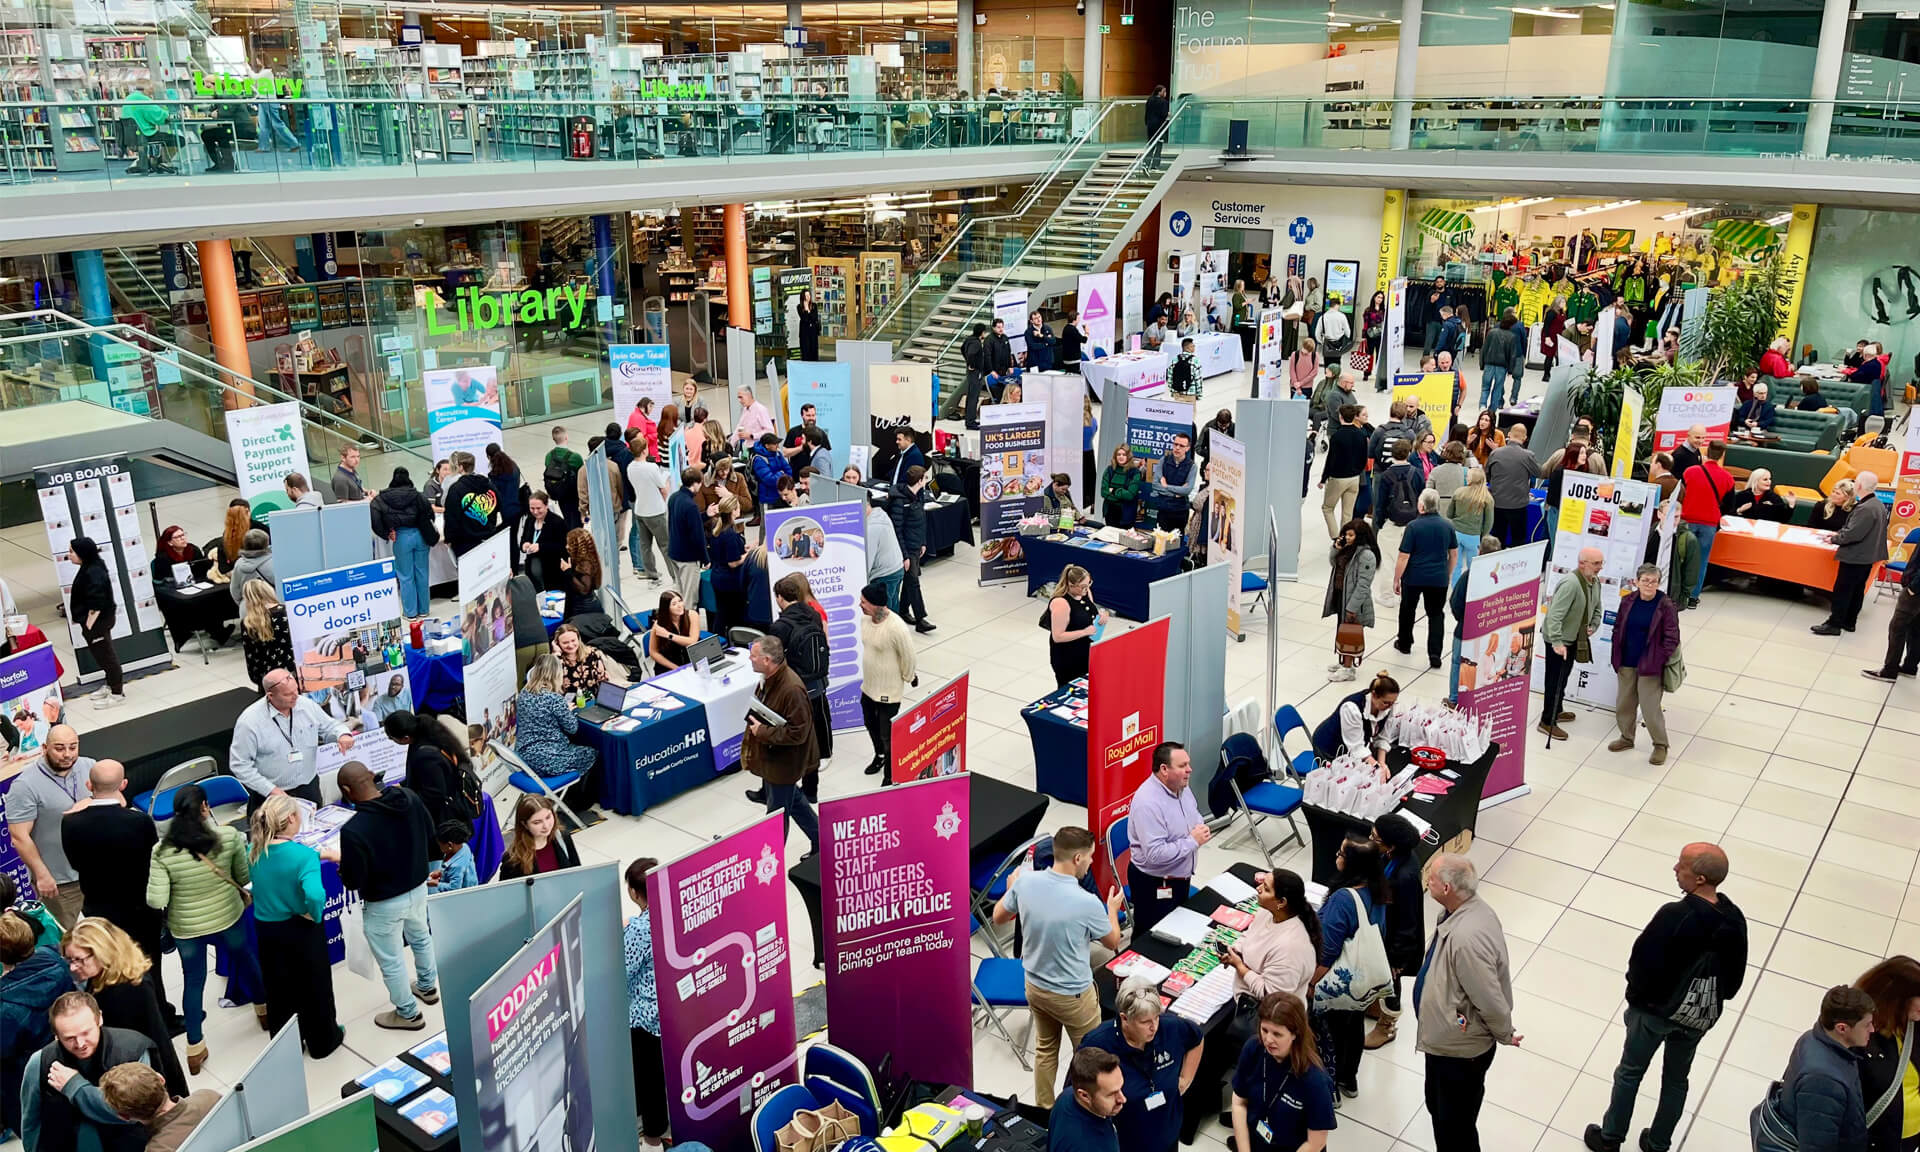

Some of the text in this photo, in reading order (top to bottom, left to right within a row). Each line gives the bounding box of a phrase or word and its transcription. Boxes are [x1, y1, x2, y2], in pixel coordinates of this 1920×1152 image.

[1178, 6, 1215, 28] The
[1178, 33, 1244, 54] Forum
[1176, 60, 1220, 80] Trust
[193, 70, 302, 99] Library
[640, 78, 706, 101] Library
[1211, 200, 1265, 213] Customer
[1214, 213, 1260, 224] Services
[1380, 232, 1394, 254] City
[1450, 229, 1475, 248] CITY
[1378, 258, 1388, 279] Stall
[425, 283, 588, 336] Library
[612, 352, 628, 360] Join
[1668, 404, 1728, 413] TECHNIQUE
[242, 434, 277, 447] Direct
[985, 430, 1041, 442] UK'S LARGEST
[1005, 439, 1040, 448] BUSINESSES
[1131, 428, 1176, 443] THE FOO
[1131, 438, 1165, 448] INDUSTRY
[244, 443, 296, 460] Payment
[1131, 446, 1151, 454] FARM
[247, 456, 292, 472] Support
[48, 464, 120, 486] JOB BOARD
[1568, 483, 1599, 501] JOBS
[804, 566, 846, 578] UCATION
[1502, 560, 1528, 572] Kingsley
[809, 576, 842, 585] RVICES
[294, 586, 393, 617] Open up new
[1476, 611, 1490, 620] care
[1508, 599, 1534, 610] comfort
[1483, 590, 1530, 608] Flexible tailored
[324, 608, 372, 630] doors!
[1486, 618, 1498, 628] your
[1514, 610, 1532, 618] home
[320, 744, 334, 752] Gain
[636, 728, 706, 770] EducationHR
[1108, 730, 1154, 761] Royal Mail
[898, 748, 918, 766] Looking
[833, 814, 887, 840] WE ARE
[834, 830, 900, 860] OFFICERS
[834, 854, 878, 878] STAFF
[680, 858, 752, 905] POLICE OFFICER
[835, 862, 926, 897] VOLUNTEERS
[323, 893, 346, 910] dult
[682, 874, 746, 920] RECRUITMENT
[836, 878, 934, 915] TRANSFEREES
[683, 900, 723, 934] JOURNEY
[836, 891, 952, 934] NORFOLK POLICE
[838, 930, 944, 962] Find out more about
[838, 937, 955, 974] joining our team today
[488, 952, 556, 1032] TODAY, I
[491, 990, 548, 1054] helped officers
[493, 1016, 537, 1068] make it to a
[494, 1012, 555, 1080] domestic abuse
[496, 1010, 570, 1094] incident just in time.
